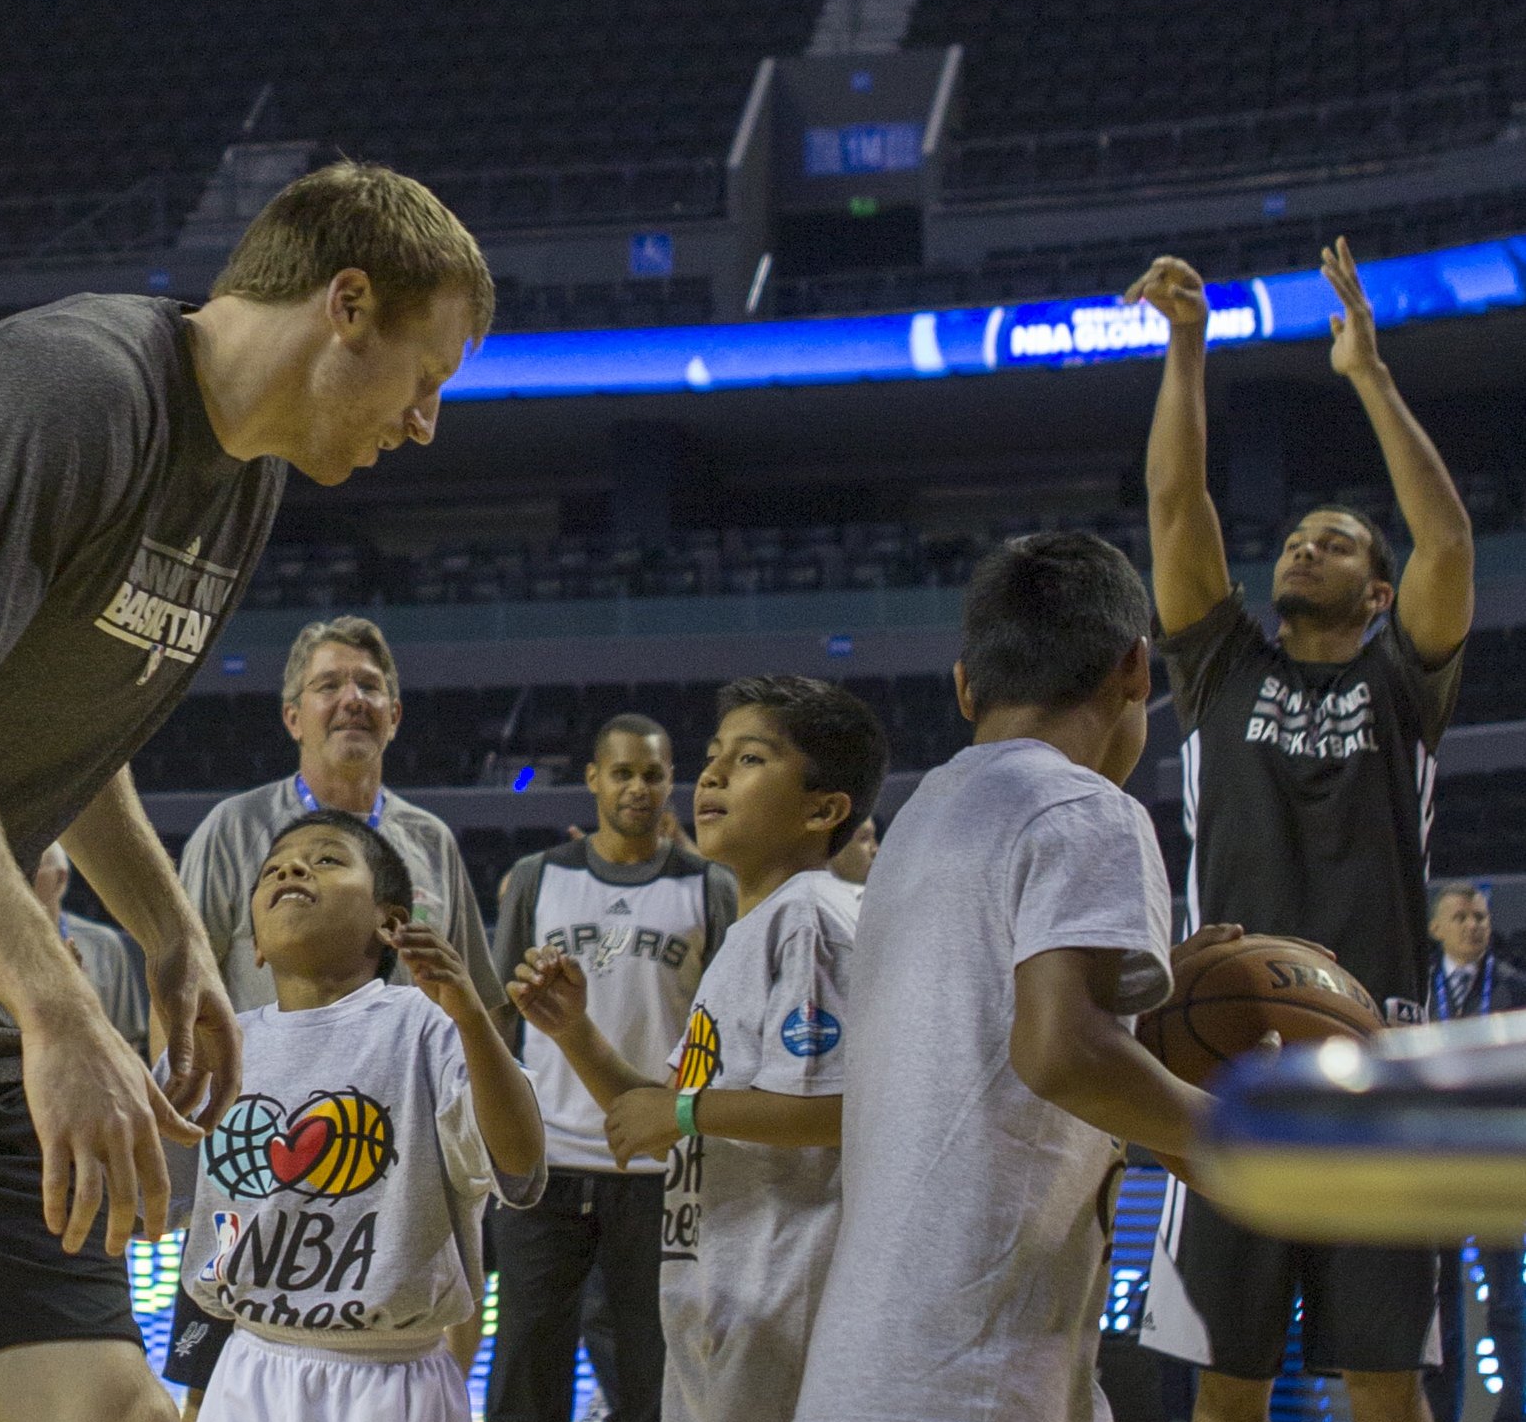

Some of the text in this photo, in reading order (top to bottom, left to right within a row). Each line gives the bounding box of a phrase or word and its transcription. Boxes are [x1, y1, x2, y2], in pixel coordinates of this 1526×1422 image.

[1011, 324, 1073, 357] NBA
[1259, 675, 1303, 714] SAN
[226, 1209, 379, 1293] NBA
